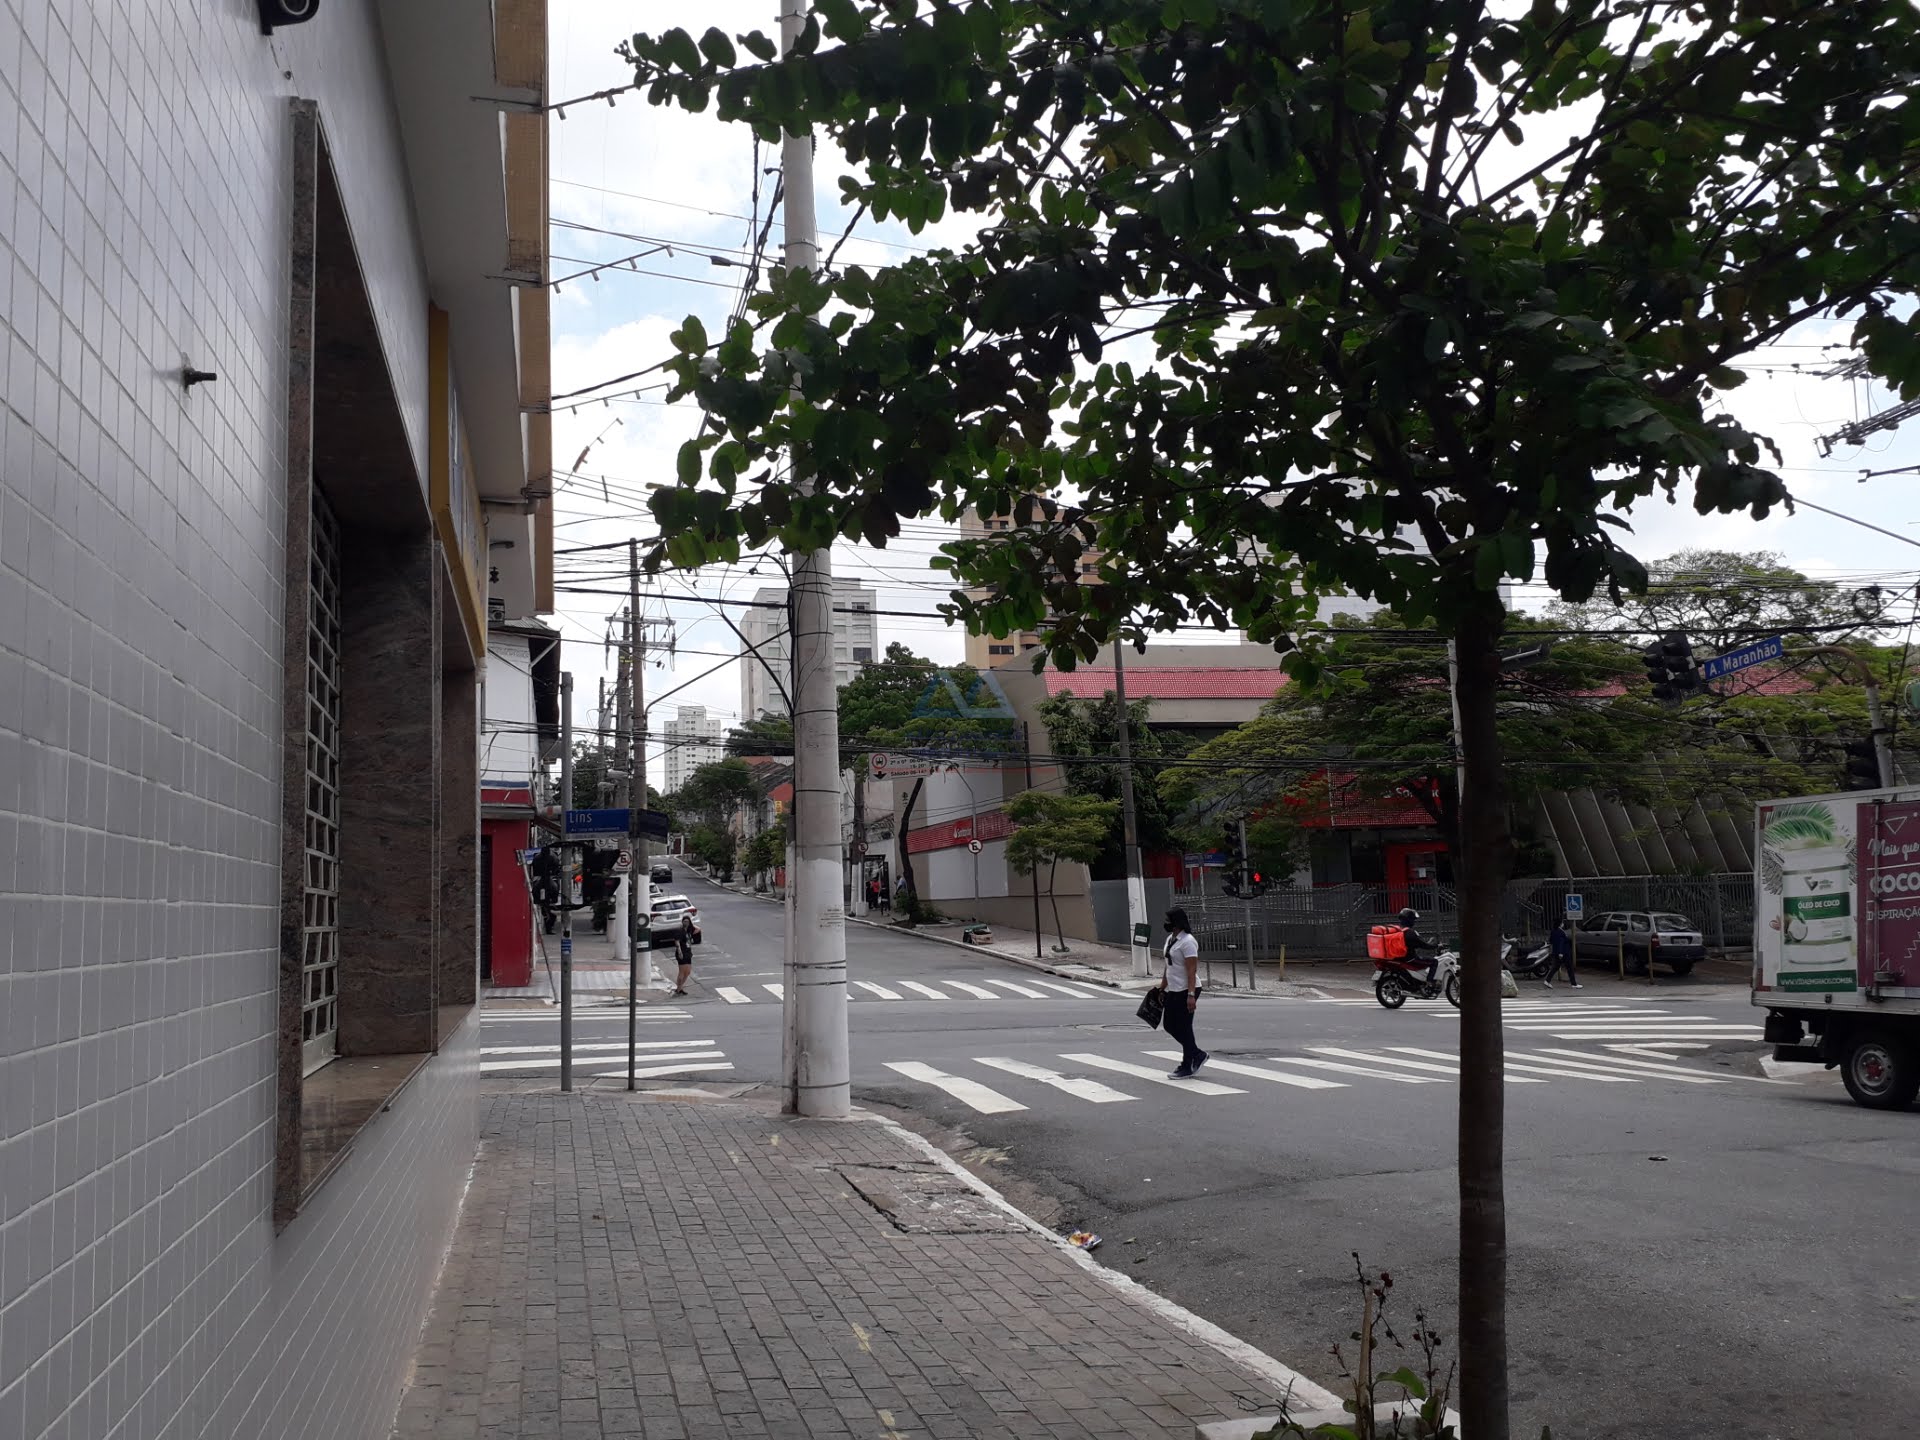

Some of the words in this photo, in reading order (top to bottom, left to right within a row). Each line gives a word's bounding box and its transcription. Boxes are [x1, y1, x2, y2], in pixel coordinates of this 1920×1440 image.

[1709, 663, 1720, 676] A.
[1722, 643, 1777, 671] Maranhão
[569, 811, 593, 824] Lins
[1867, 838, 1900, 857] Mais
[1901, 842, 1920, 861] que
[1869, 871, 1920, 893] COCO
[1823, 899, 1840, 907] COCO
